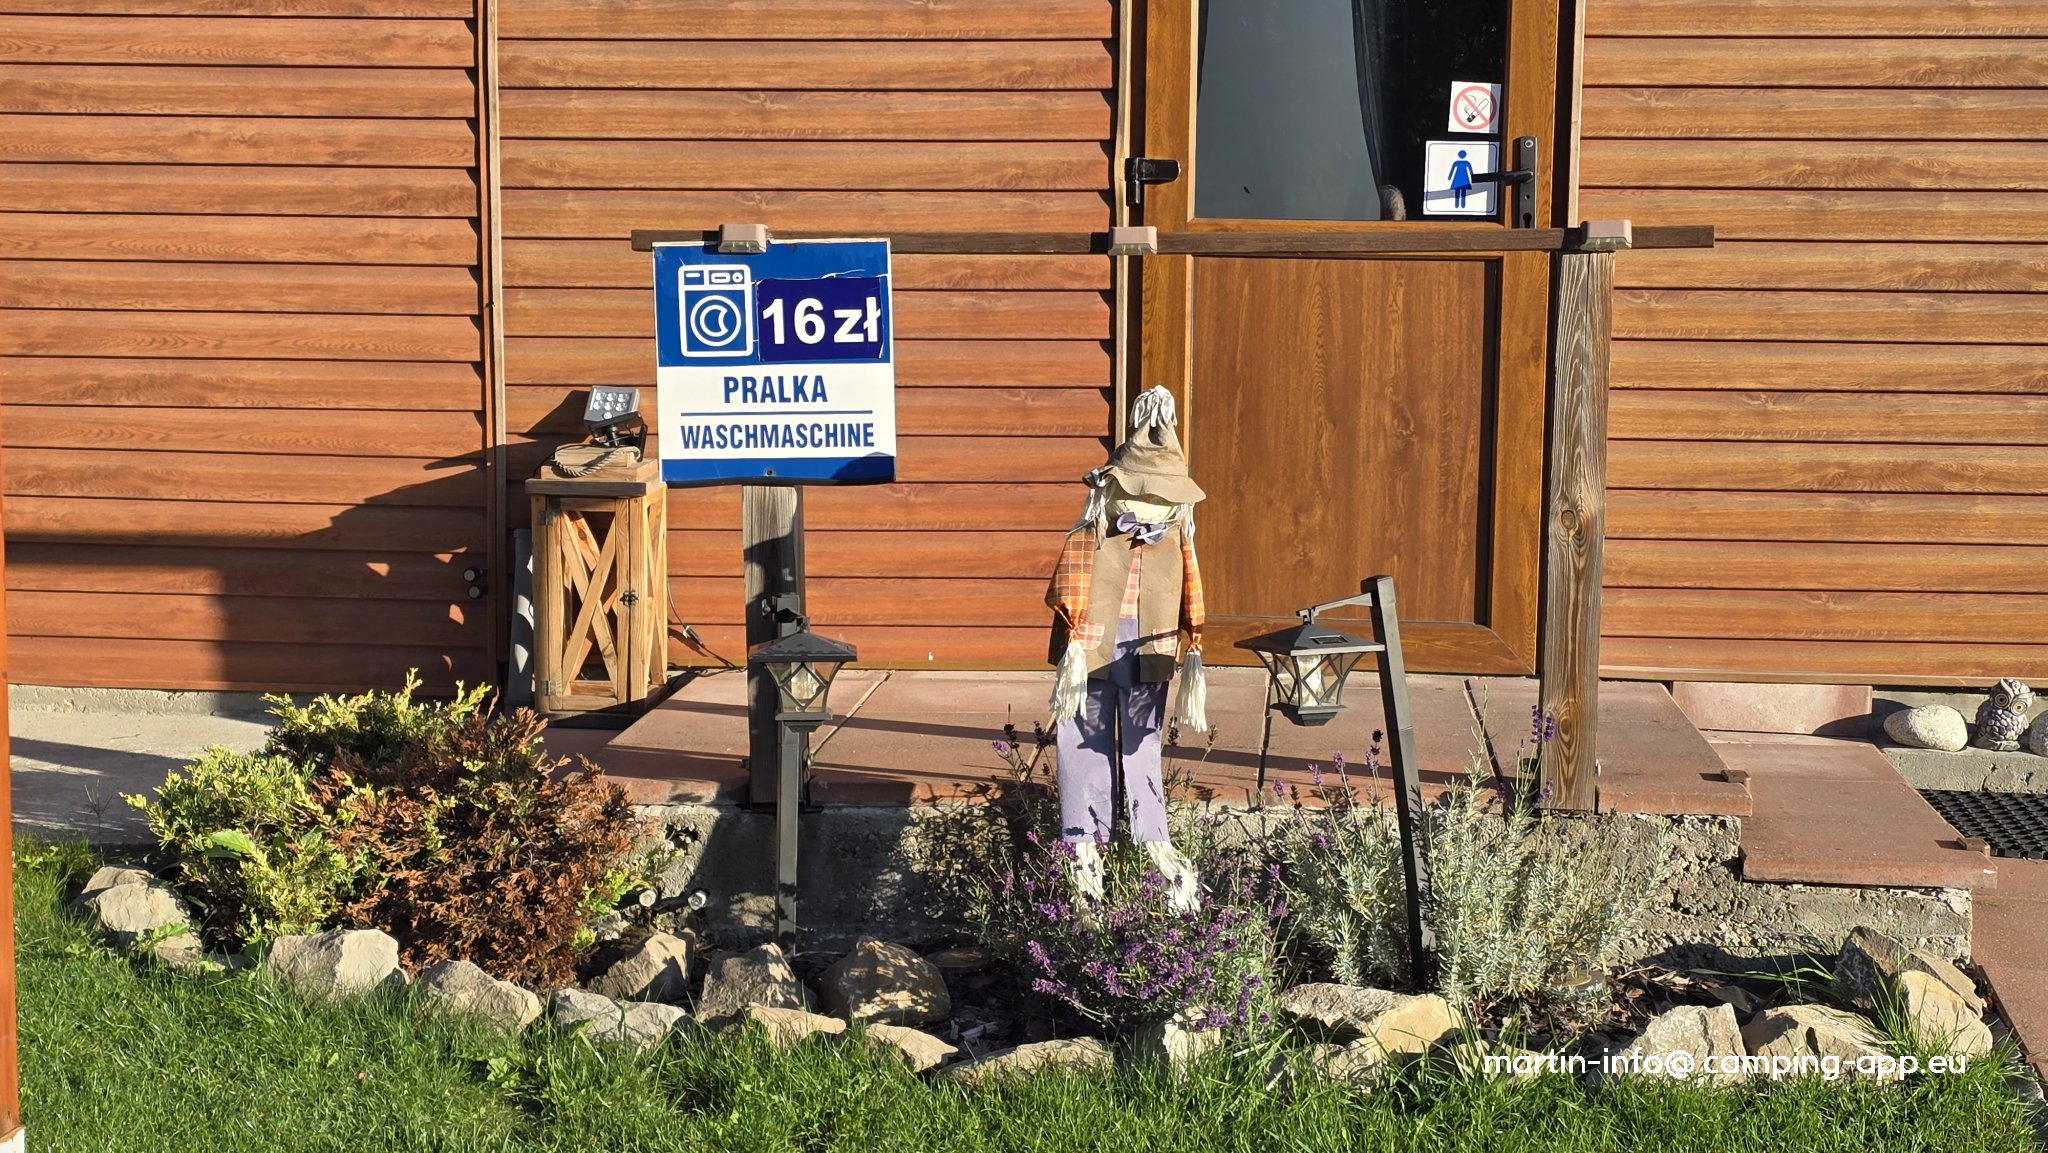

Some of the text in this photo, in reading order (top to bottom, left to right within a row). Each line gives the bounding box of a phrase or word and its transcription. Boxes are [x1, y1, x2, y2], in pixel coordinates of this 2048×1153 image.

[762, 296, 881, 345] 16 zł
[723, 375, 828, 404] PRALKA
[680, 422, 875, 450] WASCHMASCHINE
